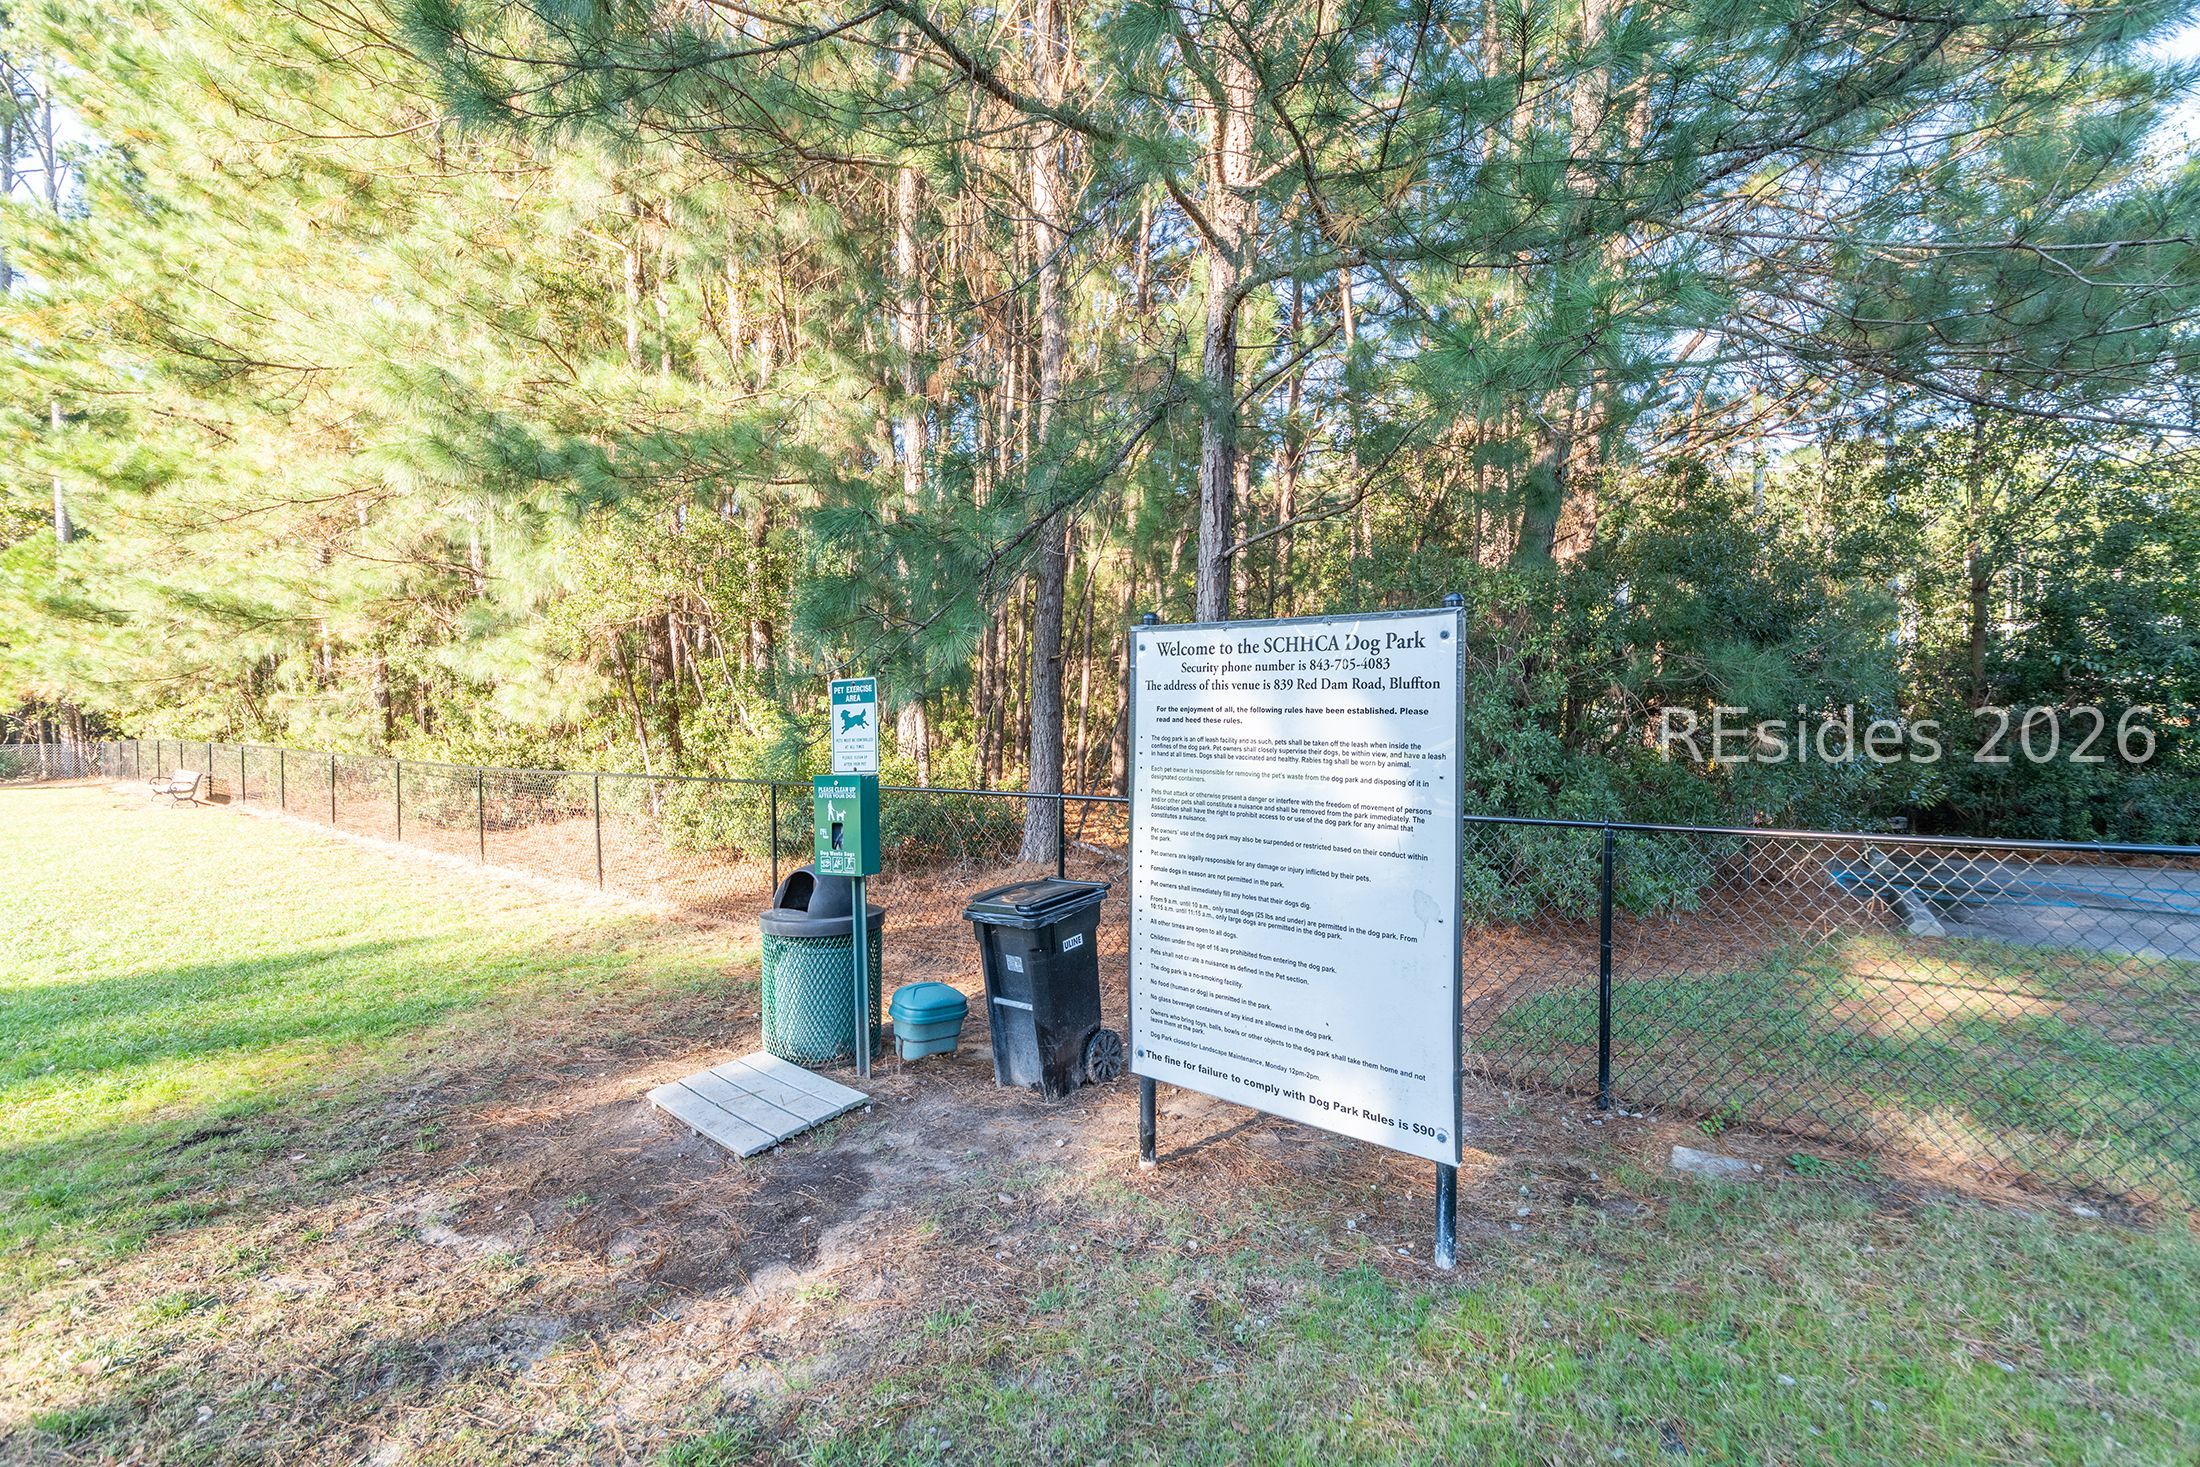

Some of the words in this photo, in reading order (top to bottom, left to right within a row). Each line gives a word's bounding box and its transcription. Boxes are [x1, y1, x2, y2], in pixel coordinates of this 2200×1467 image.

[1156, 640, 1216, 657] Welcome
[1219, 643, 1233, 655] to
[1238, 638, 1260, 654] the
[1263, 635, 1340, 653] SCHHCA
[1345, 634, 1381, 656] Dog
[1385, 630, 1426, 649] Park
[1181, 662, 1219, 675] Security
[1221, 661, 1252, 675] phone
[1255, 661, 1296, 671] number
[1298, 660, 1307, 670] is
[1309, 657, 1391, 671] 843-705-4083
[833, 686, 844, 694] PET
[846, 685, 873, 693] EXERCISE
[1147, 680, 1162, 690] The
[1163, 680, 1197, 690] address
[1199, 680, 1209, 690] of
[1211, 680, 1229, 690] this
[1231, 682, 1260, 690] venue
[1263, 679, 1271, 690] is
[1273, 679, 1294, 690] 839
[1297, 679, 1318, 690] Red
[1321, 679, 1348, 690] Dam
[1352, 679, 1388, 692] Road,
[1389, 679, 1440, 689] Bluffton
[845, 694, 861, 702] AREA
[1179, 706, 1214, 715] enjoyment
[1224, 706, 1237, 715] all,
[1236, 706, 1249, 714] the
[1250, 706, 1283, 716] following
[1347, 707, 1399, 715] established.
[1172, 716, 1184, 724] and
[1185, 716, 1202, 724] heed
[1151, 734, 1161, 742] The
[1161, 735, 1171, 744] dog
[1171, 735, 1183, 744] park
[1183, 735, 1189, 743] is
[1205, 736, 1220, 744] leash
[1219, 737, 1238, 746] facility
[1239, 737, 1250, 745] and
[1274, 739, 1287, 747] pets
[1339, 740, 1350, 748] the
[1188, 744, 1198, 753] dog
[1258, 747, 1278, 756] closely
[1278, 748, 1307, 756] supervise
[1308, 748, 1322, 756] their
[1342, 749, 1350, 757] be
[1427, 752, 1447, 760] leash
[1150, 849, 1159, 857] Pet
[1187, 853, 1204, 864] legally
[1204, 858, 1236, 866] responsible
[1236, 859, 1245, 867] for
[1245, 862, 1256, 870] any
[1256, 862, 1279, 873] damage
[1287, 865, 1305, 876] injury
[1305, 868, 1330, 877] inflicted
[1330, 871, 1339, 880] by
[1340, 872, 1355, 881] their
[1063, 936, 1082, 949] ULINE
[1146, 1050, 1163, 1063] The
[1164, 1055, 1181, 1068] fine
[1183, 1060, 1196, 1072] for
[1198, 1064, 1229, 1079] failure
[1231, 1074, 1241, 1085] to
[1243, 1080, 1280, 1095] comply
[1282, 1090, 1306, 1102] with
[1309, 1095, 1330, 1111] Dog
[1333, 1102, 1359, 1116] Park
[1362, 1109, 1395, 1125] Rules
[1398, 1118, 1409, 1129] is
[1412, 1122, 1436, 1136] $90
